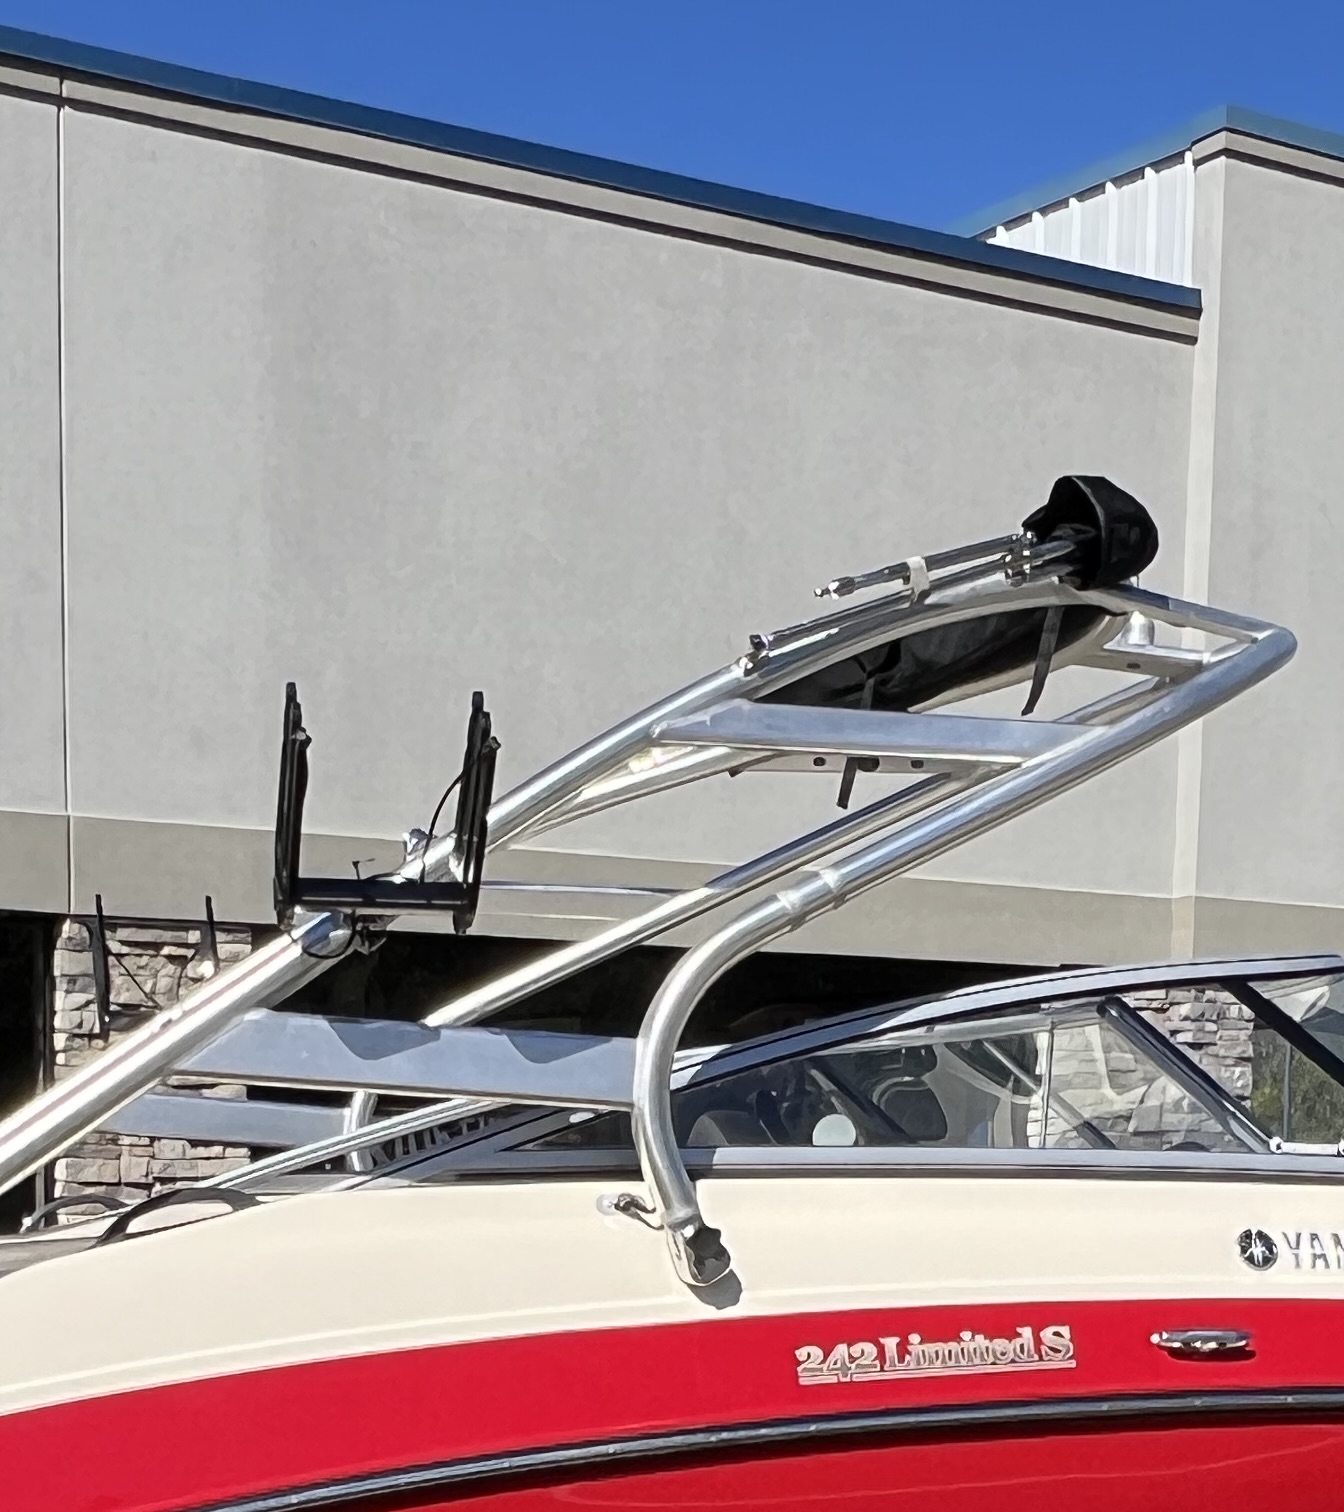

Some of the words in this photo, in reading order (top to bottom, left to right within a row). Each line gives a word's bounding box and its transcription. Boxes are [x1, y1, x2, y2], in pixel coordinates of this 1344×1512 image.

[795, 1343, 881, 1381] 242
[879, 1326, 1039, 1371] Limited
[1040, 1325, 1075, 1362] S
